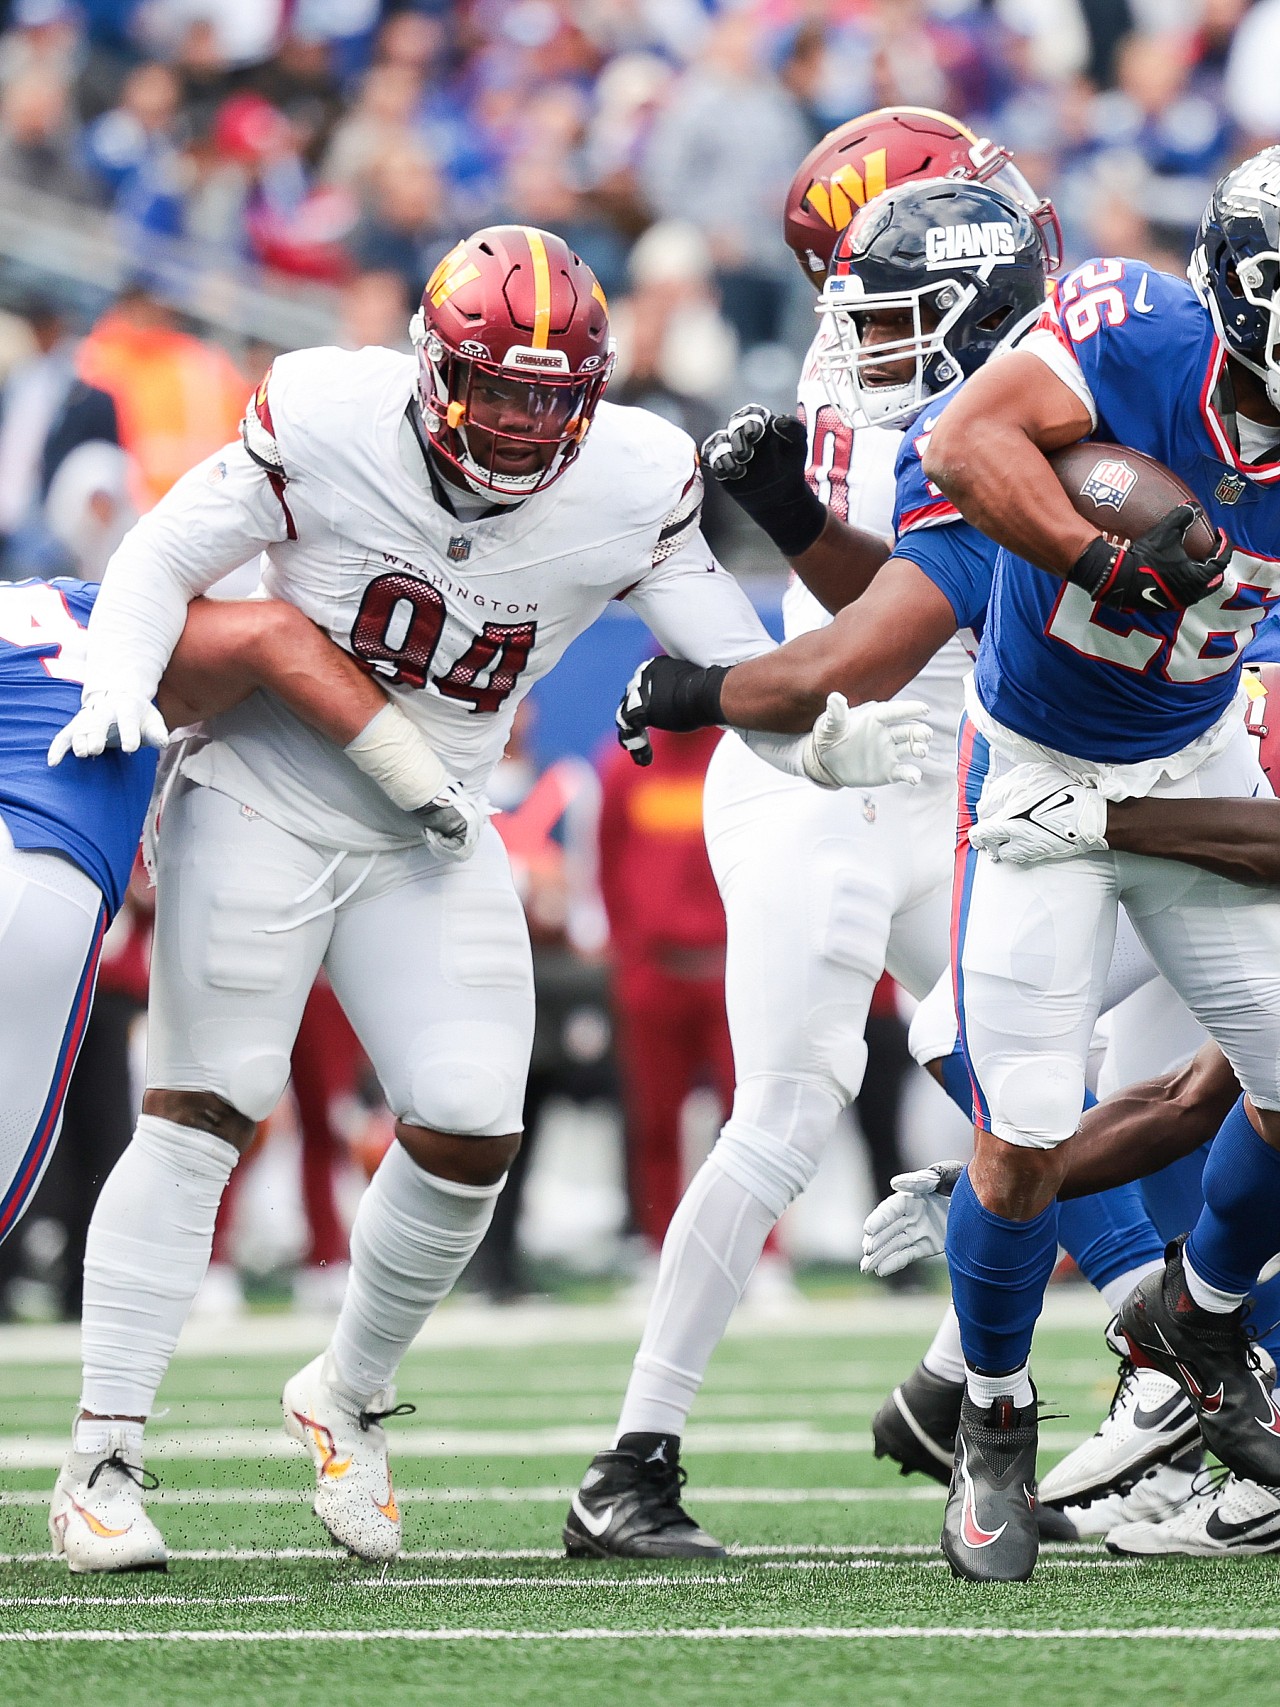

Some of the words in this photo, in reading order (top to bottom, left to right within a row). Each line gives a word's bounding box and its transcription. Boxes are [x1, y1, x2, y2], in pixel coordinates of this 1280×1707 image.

[925, 222, 1016, 262] GIANTS
[1062, 257, 1129, 344] 26
[515, 354, 563, 367] COMMANDERS
[1098, 463, 1134, 489] NFL
[382, 552, 540, 614] WASHINGTON
[350, 572, 539, 714] 94
